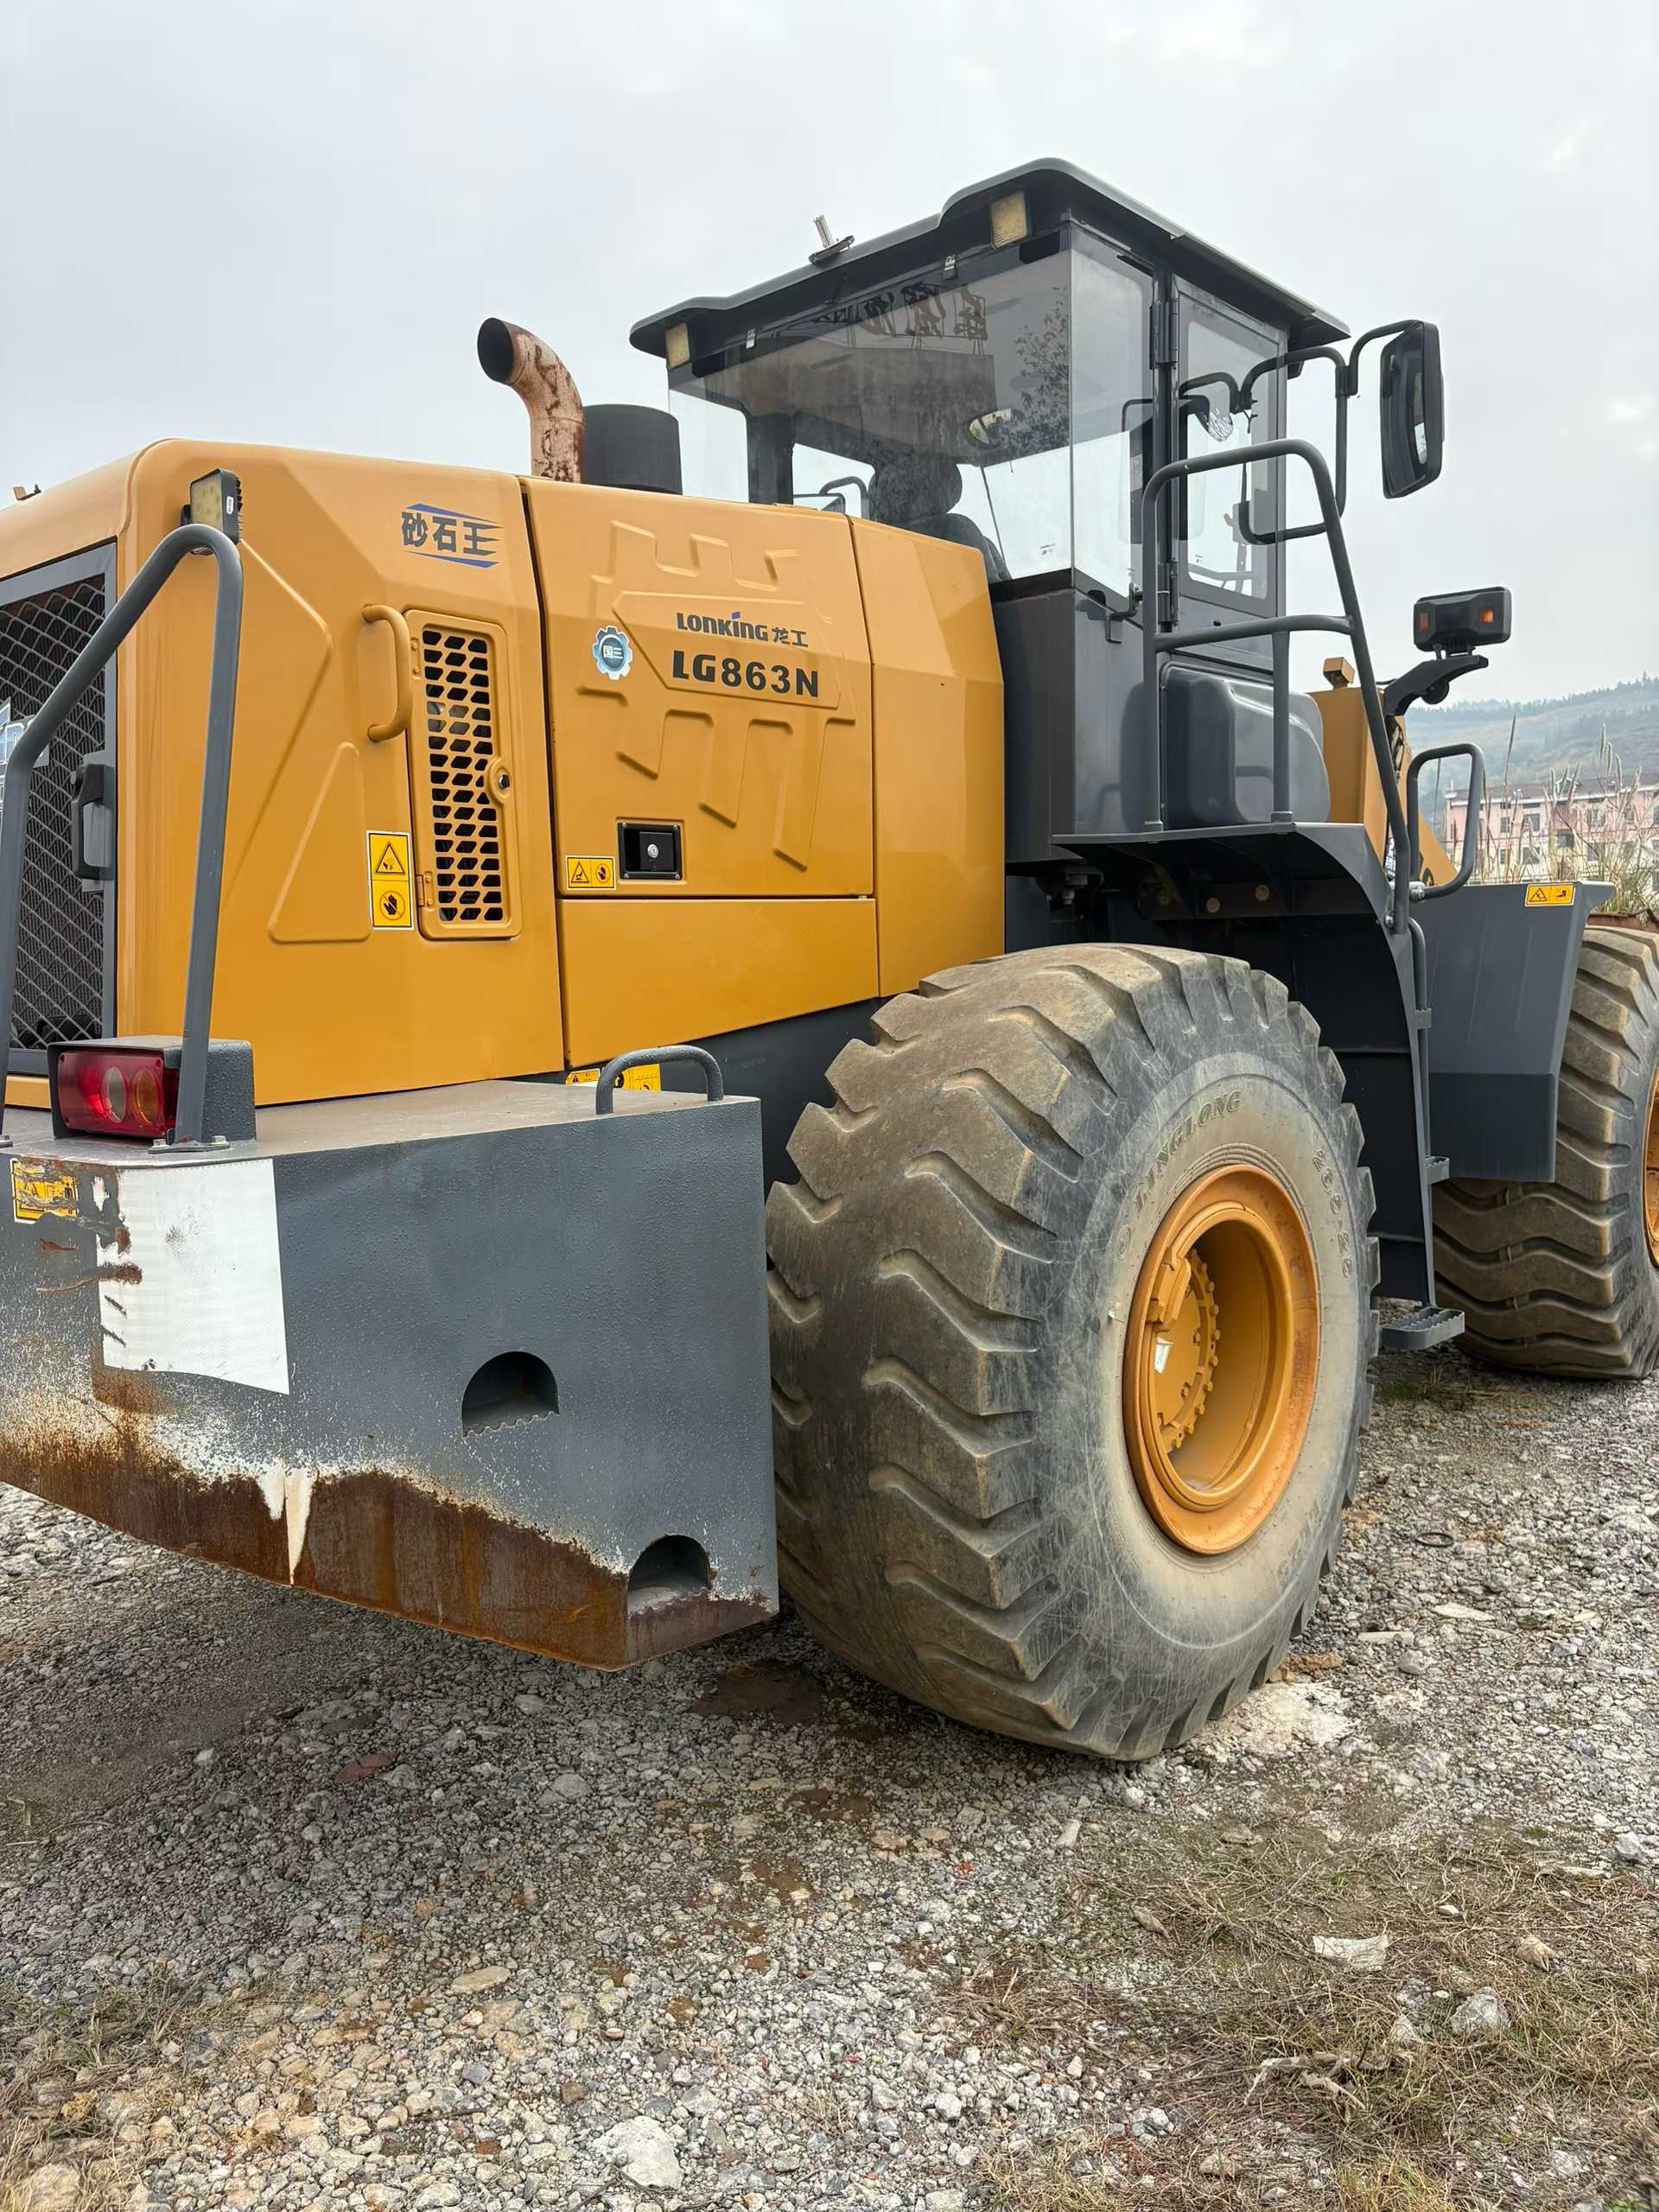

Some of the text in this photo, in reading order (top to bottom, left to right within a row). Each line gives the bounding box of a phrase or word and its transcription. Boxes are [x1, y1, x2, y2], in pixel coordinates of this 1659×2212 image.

[401, 511, 505, 556] 砂石王
[772, 627, 809, 647] 龙工
[672, 650, 818, 697] LG863N
